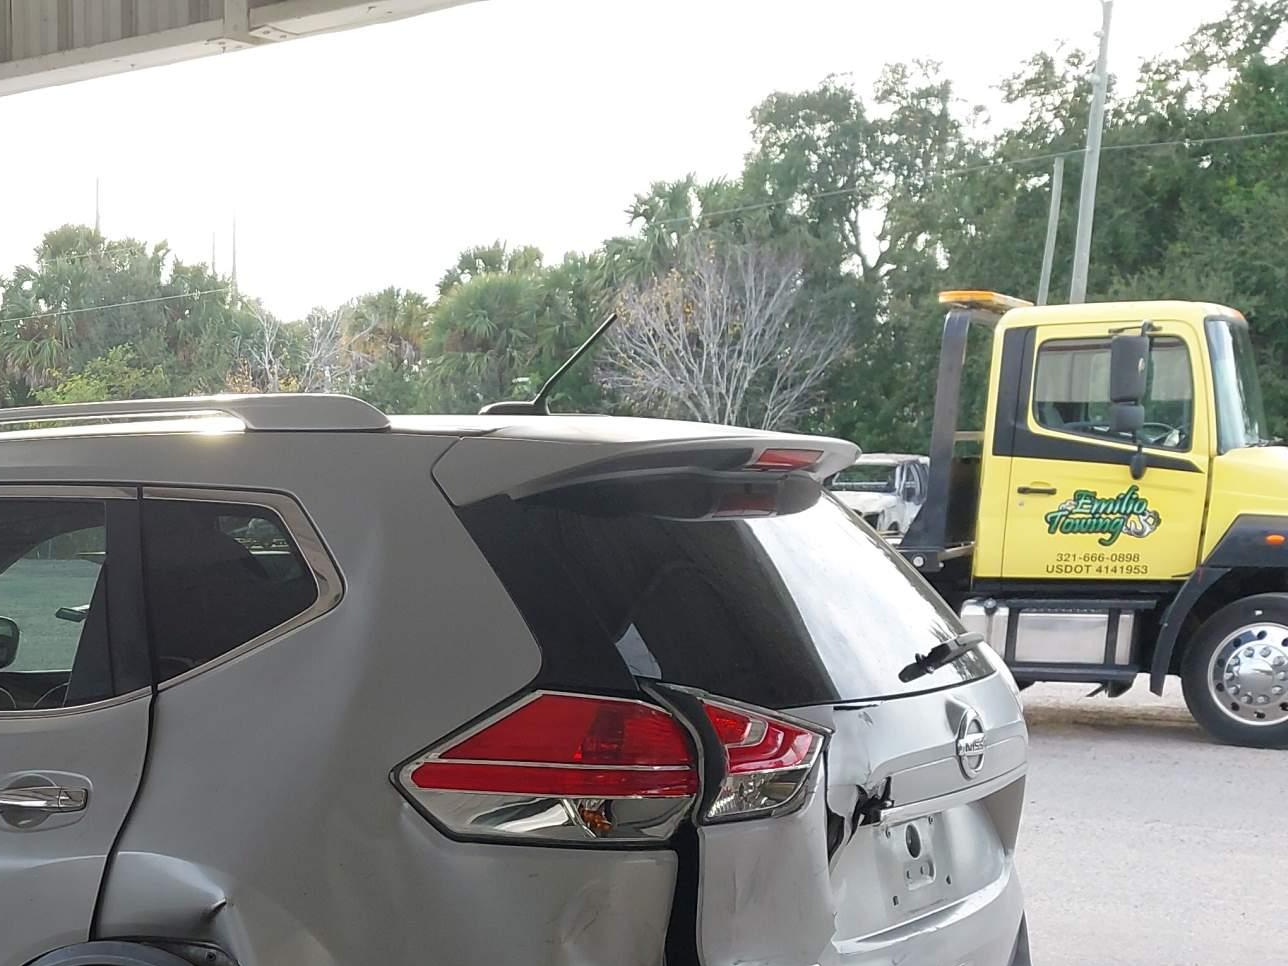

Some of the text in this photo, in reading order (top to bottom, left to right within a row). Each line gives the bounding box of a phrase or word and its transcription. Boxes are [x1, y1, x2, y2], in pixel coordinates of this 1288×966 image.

[1073, 485, 1148, 516] Emilio
[1045, 511, 1125, 546] Towing
[1056, 553, 1140, 563] 321-666-0898
[1046, 564, 1148, 574] USDOT 4141953
